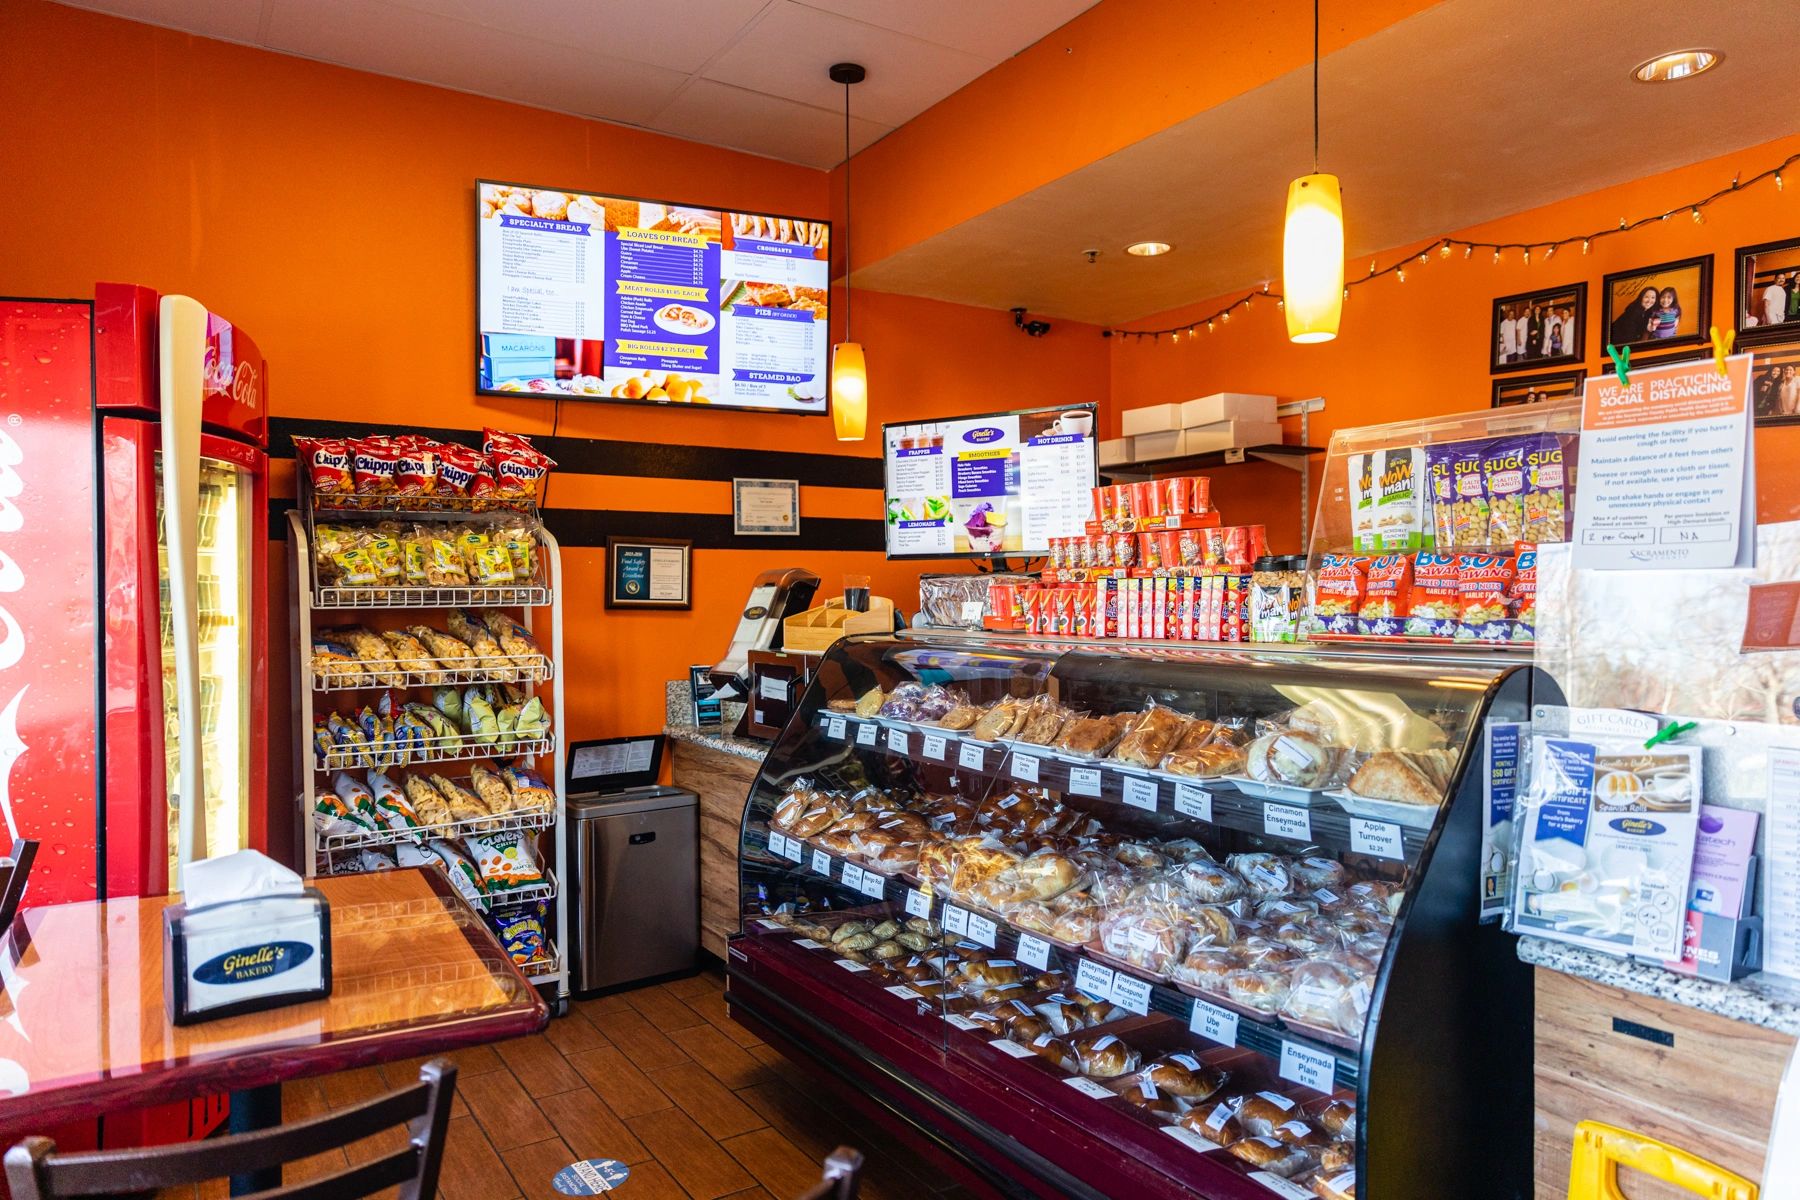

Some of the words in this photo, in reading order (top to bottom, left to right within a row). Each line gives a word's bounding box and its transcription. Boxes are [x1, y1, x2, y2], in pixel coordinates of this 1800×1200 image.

[509, 218, 555, 230] SPECIALTY
[556, 223, 582, 233] BREAD
[626, 231, 658, 241] LOAVES
[672, 236, 698, 245] BREAD
[755, 308, 772, 316] PIES
[749, 372, 785, 381] STEAMED
[786, 374, 801, 382] BAO
[1598, 386, 1618, 397] WE
[1621, 382, 1644, 394] ARE
[1650, 374, 1728, 391] PRACTICING
[1600, 393, 1644, 407] SOCIAL
[1650, 381, 1732, 404] DISTANCING
[1597, 436, 1617, 444] Avoid
[1618, 433, 1646, 442] entering
[1661, 429, 1685, 438] facility
[1695, 427, 1708, 435] you
[1637, 440, 1659, 448] cough
[1591, 457, 1622, 465] Maintain
[1629, 454, 1658, 462] distance
[1710, 446, 1733, 455] others
[355, 457, 397, 474] Chippy
[500, 462, 546, 478] Chippy
[1629, 468, 1652, 476] cough
[1676, 465, 1696, 473] cloth
[1676, 475, 1694, 483] your
[1695, 472, 1719, 480] elbow
[1383, 473, 1415, 497] mani
[1386, 492, 1410, 501] GARLIC
[1675, 490, 1701, 498] engage
[1653, 499, 1682, 508] physical
[1684, 497, 1710, 505] contact
[1602, 535, 1616, 543] per
[1618, 531, 1645, 542] Couple
[1630, 549, 1689, 558] SACRAMENTO
[1479, 582, 1501, 590] NUTS
[1465, 591, 1484, 599] GARLIC
[1577, 714, 1603, 725] GIFT
[1608, 715, 1649, 730] CARDS
[1181, 785, 1205, 799] Strawberry
[1182, 800, 1202, 811] Croissant
[1268, 804, 1303, 818] Cinnamon
[1266, 814, 1306, 828] Enseymada
[1542, 814, 1564, 822] Ginelle's
[1565, 816, 1584, 824] Bakery
[1622, 820, 1653, 830] Ginelle's
[1364, 822, 1386, 834] Apple
[495, 840, 517, 849] CHIPS
[1358, 832, 1392, 846] Turnover
[1369, 845, 1384, 853] $2.25
[948, 906, 962, 915] Cheese
[948, 914, 960, 923] Bread
[1029, 936, 1041, 945] Cream
[1023, 942, 1036, 951] Cheese
[1036, 947, 1044, 955] Roll
[224, 946, 284, 975] Ginelle's
[236, 964, 274, 979] BAKERY
[1081, 960, 1110, 978] Enseymada
[1081, 970, 1107, 986] Chocolate
[1117, 974, 1146, 992] Enseymada
[1117, 983, 1143, 999] Macapuno
[1196, 1000, 1234, 1021] Enseymada
[1206, 1016, 1220, 1028] Ube
[1287, 1047, 1332, 1070] Enseymada
[1298, 1063, 1318, 1077] Plain
